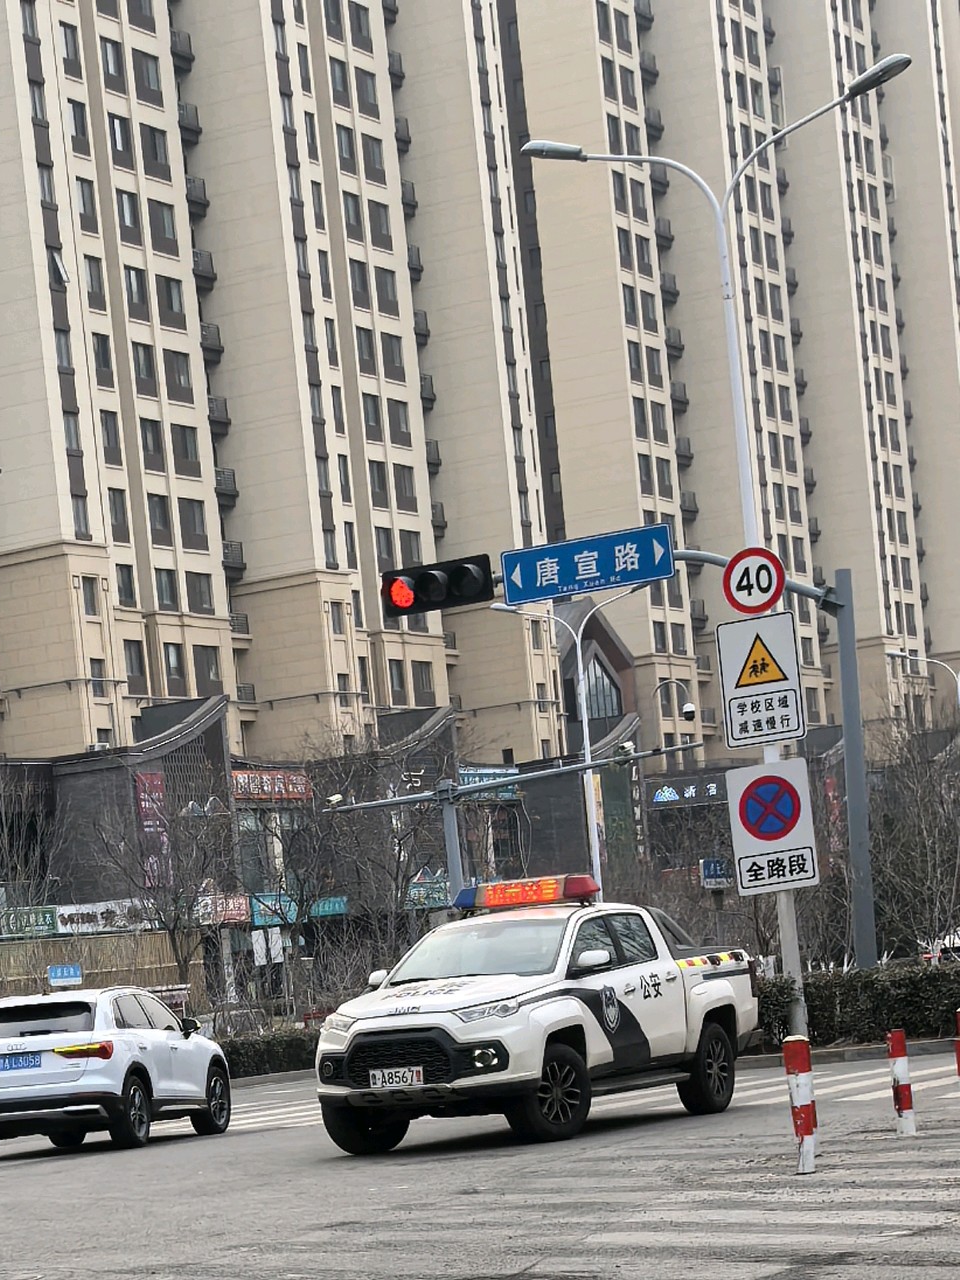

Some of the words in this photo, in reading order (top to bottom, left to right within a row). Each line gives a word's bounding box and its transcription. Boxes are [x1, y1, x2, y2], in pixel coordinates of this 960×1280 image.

[536, 542, 640, 587] 唐宣路
[735, 563, 772, 596] 40
[737, 695, 790, 716] 学校区域
[738, 714, 791, 735] 减速慢行
[746, 854, 809, 882] 全路段
[640, 972, 662, 999] 公安
